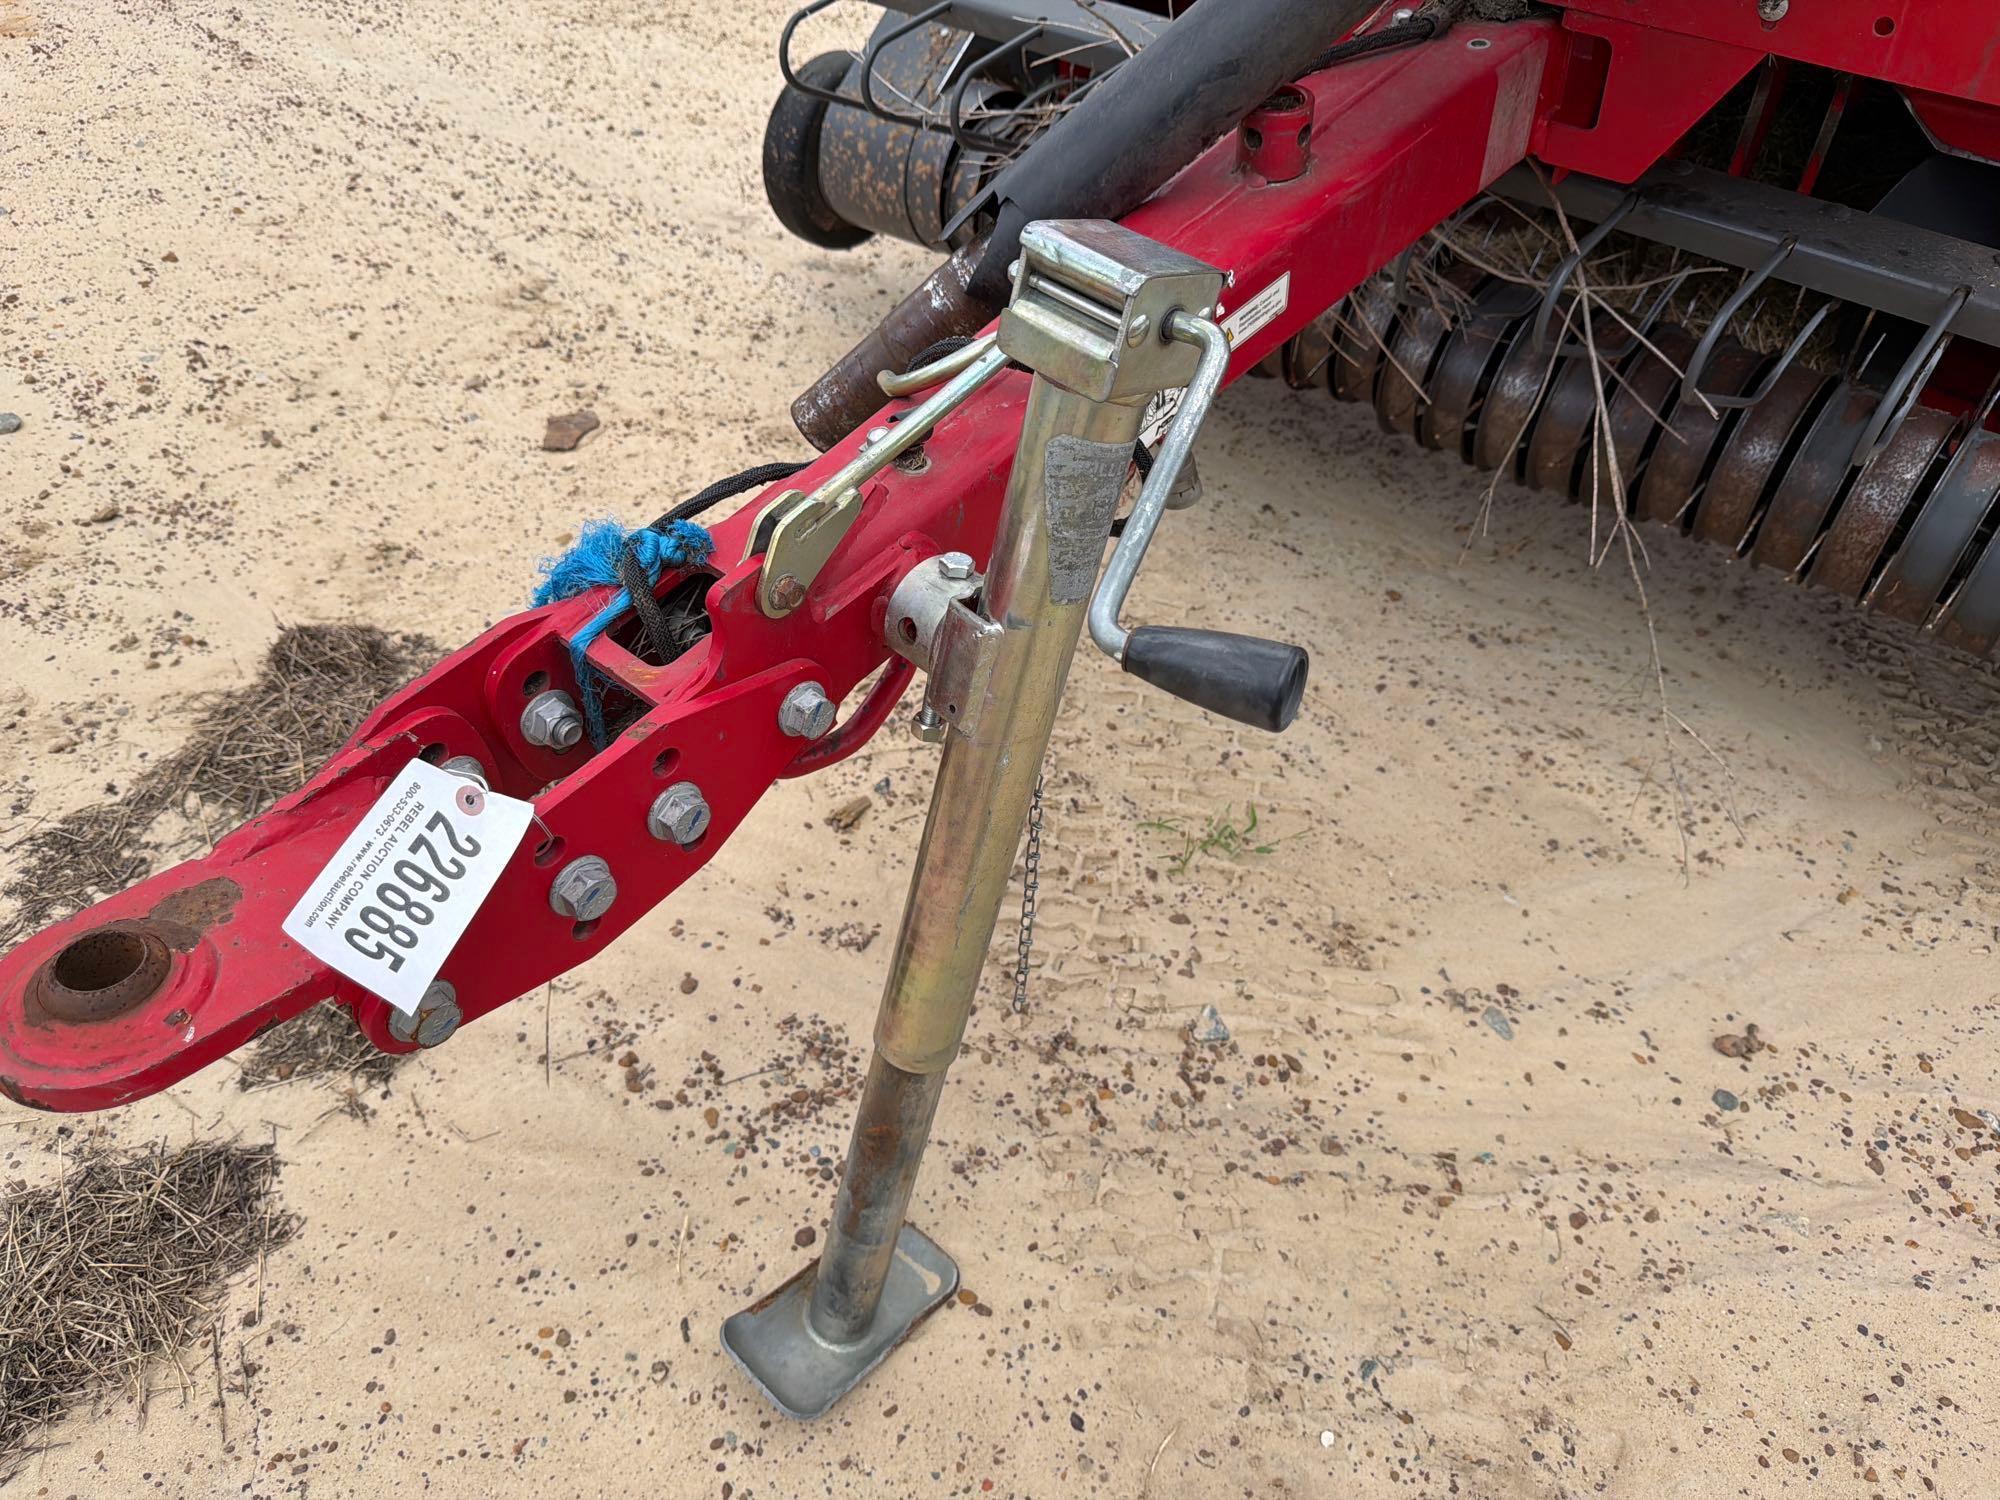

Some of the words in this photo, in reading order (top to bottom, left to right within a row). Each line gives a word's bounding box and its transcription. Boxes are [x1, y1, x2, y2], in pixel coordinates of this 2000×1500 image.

[375, 782, 422, 836] 800-533-0673
[395, 801, 425, 833] REBEL
[362, 834, 399, 880] AUCTION
[305, 839, 375, 928] www.rebelauction.com
[325, 880, 364, 930] COMPANY
[344, 810, 482, 973] 226885
